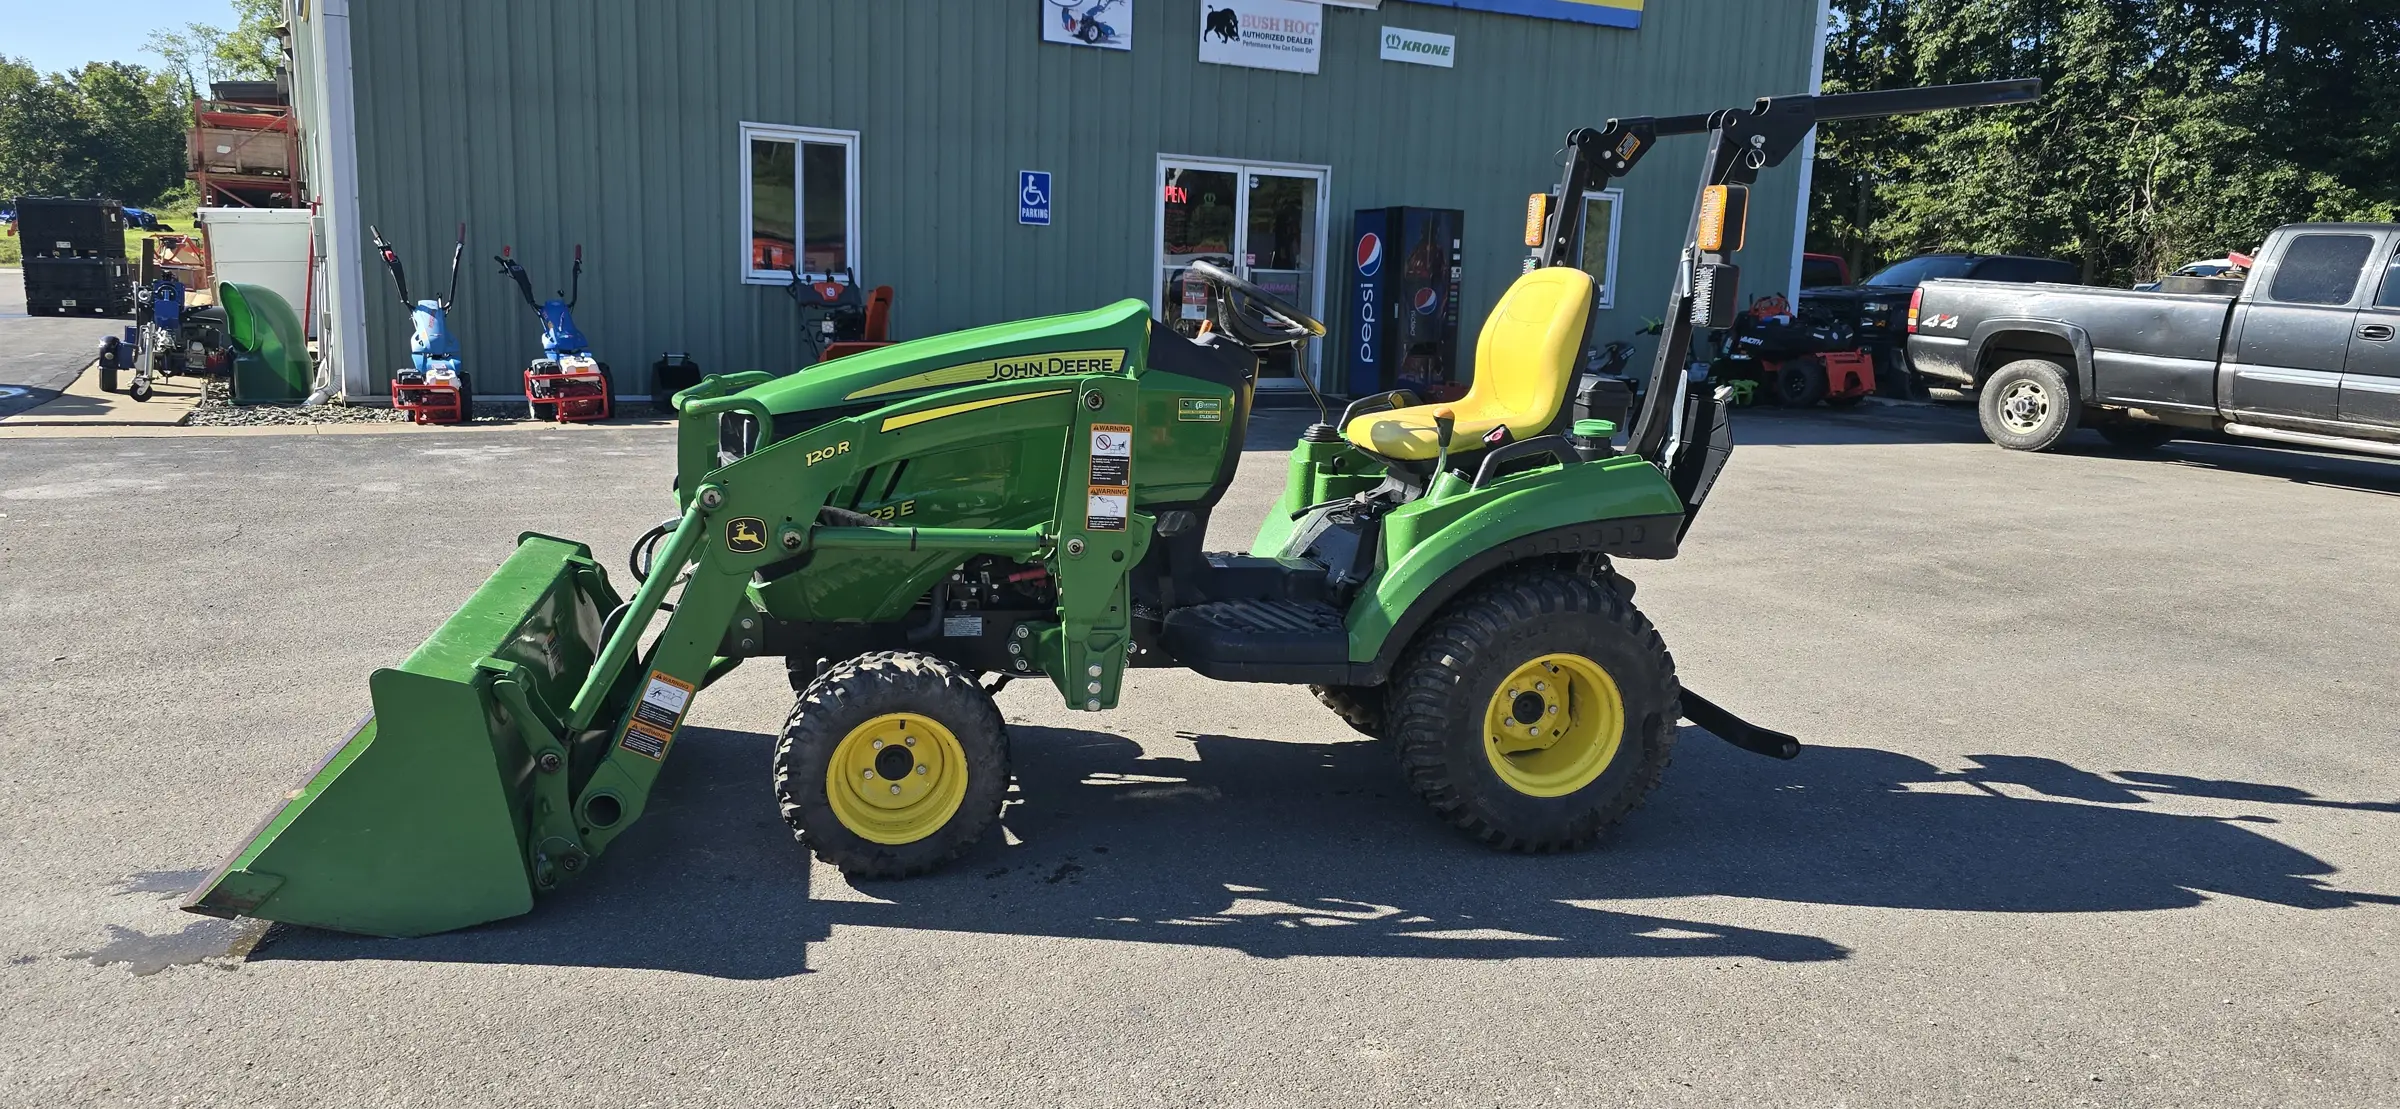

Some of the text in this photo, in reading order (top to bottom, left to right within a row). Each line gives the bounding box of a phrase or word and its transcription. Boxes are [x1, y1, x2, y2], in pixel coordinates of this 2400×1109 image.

[1241, 14, 1280, 31] BUSH
[1242, 30, 1313, 46] AUTHORIZED DEALER
[1242, 40, 1272, 49] Performance
[1273, 43, 1281, 51] You
[1281, 44, 1291, 52] Can
[1401, 40, 1451, 56] KRONE
[1164, 185, 1188, 204] PEN
[1022, 207, 1049, 219] PARKING
[1361, 283, 1376, 363] pepsi
[986, 357, 1114, 380] JOHN DEERE
[804, 440, 851, 467] 120 R
[899, 499, 916, 517] E
[662, 675, 689, 690] WARNING
[640, 726, 667, 740] WARNING
